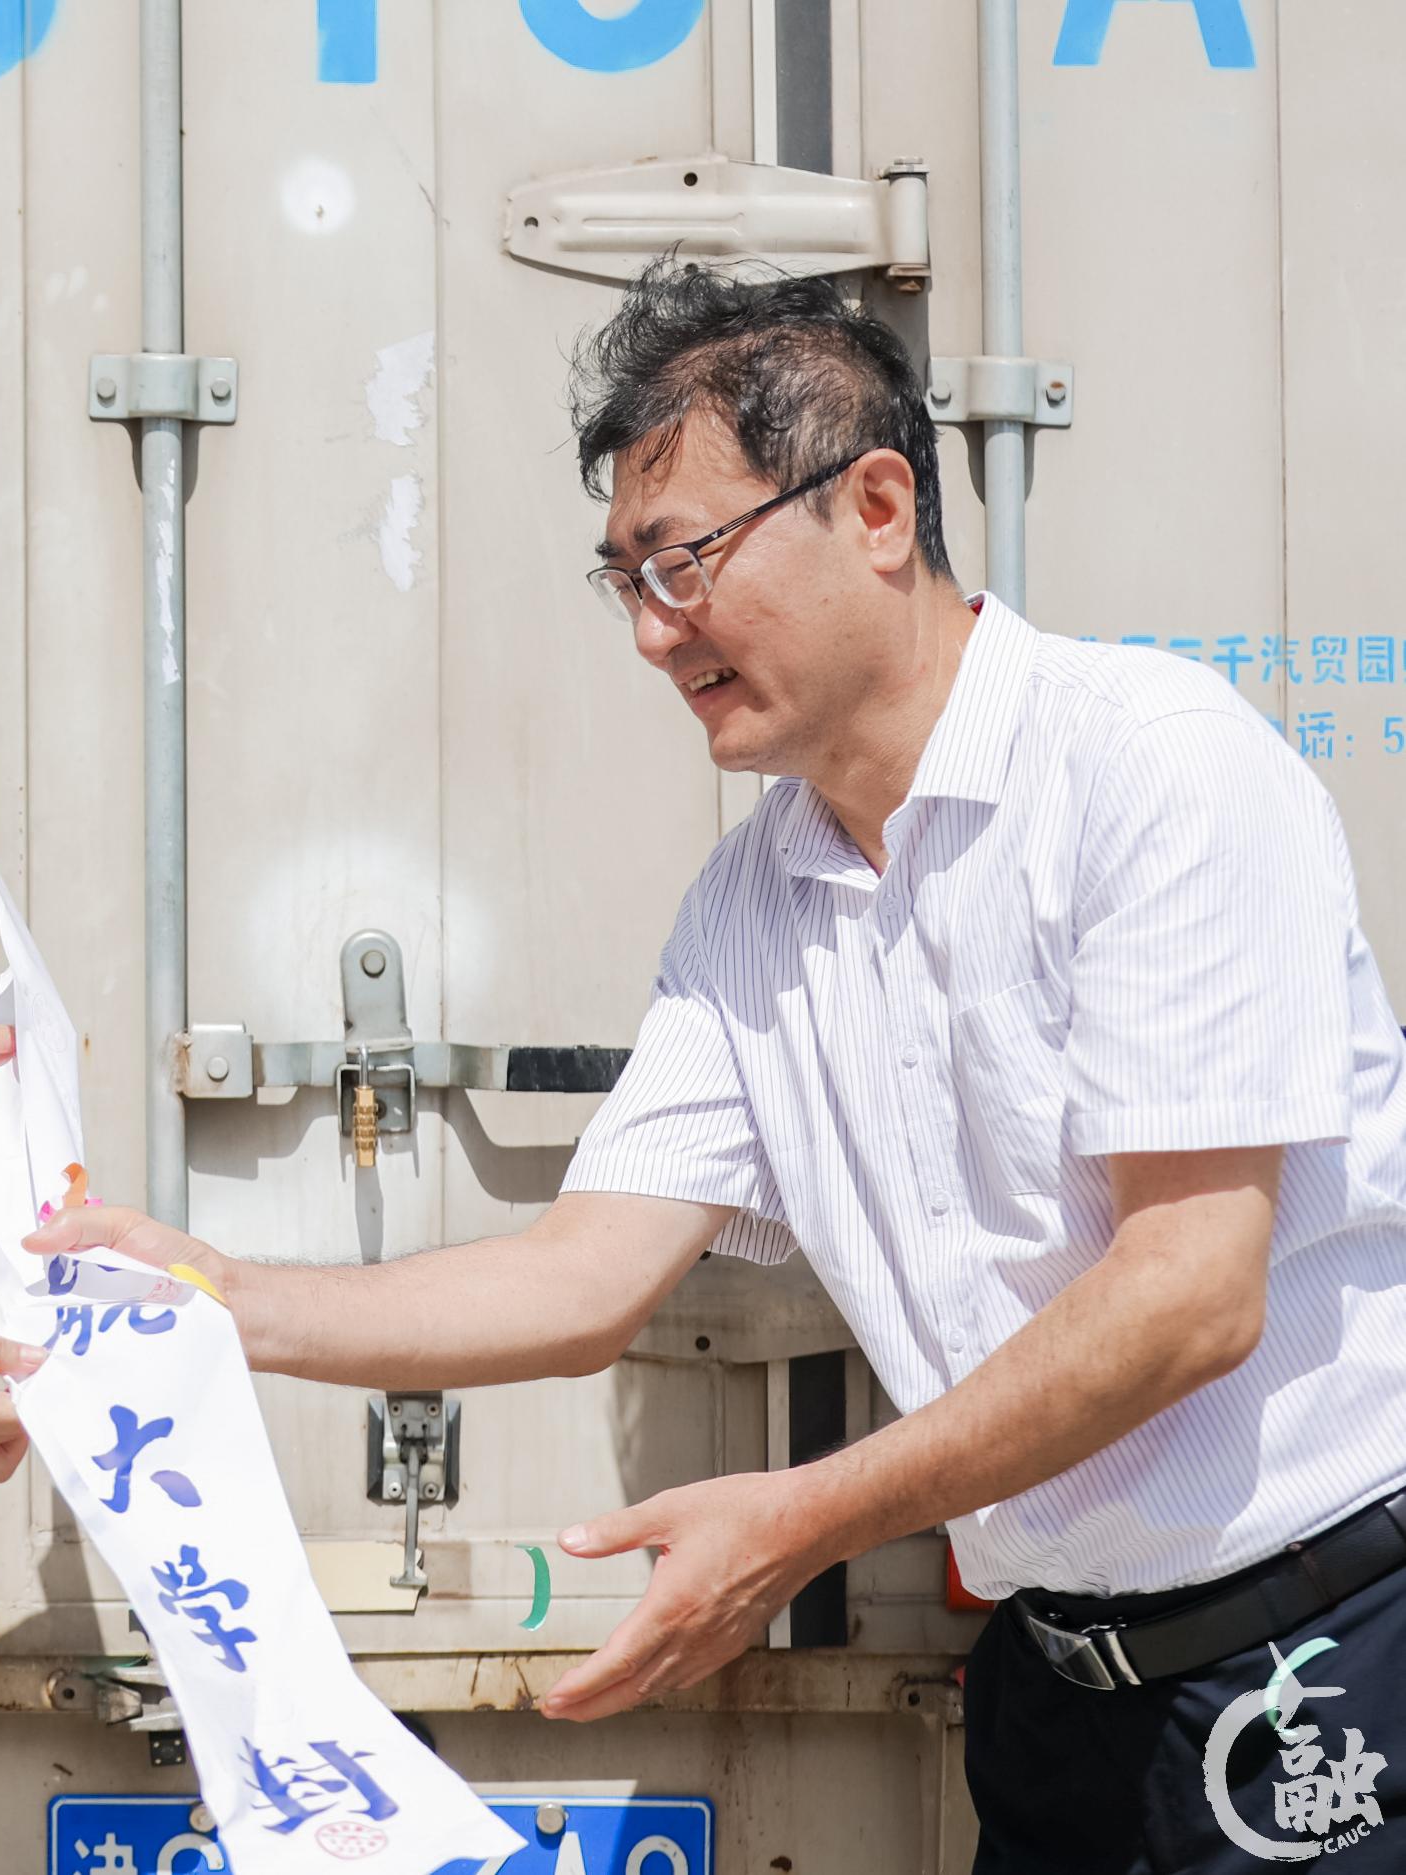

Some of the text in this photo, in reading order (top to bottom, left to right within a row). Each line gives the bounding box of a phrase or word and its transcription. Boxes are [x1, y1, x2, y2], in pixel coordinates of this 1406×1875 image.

[1079, 634, 1406, 684] 千汽贸园
[1264, 711, 1406, 760] 话：5
